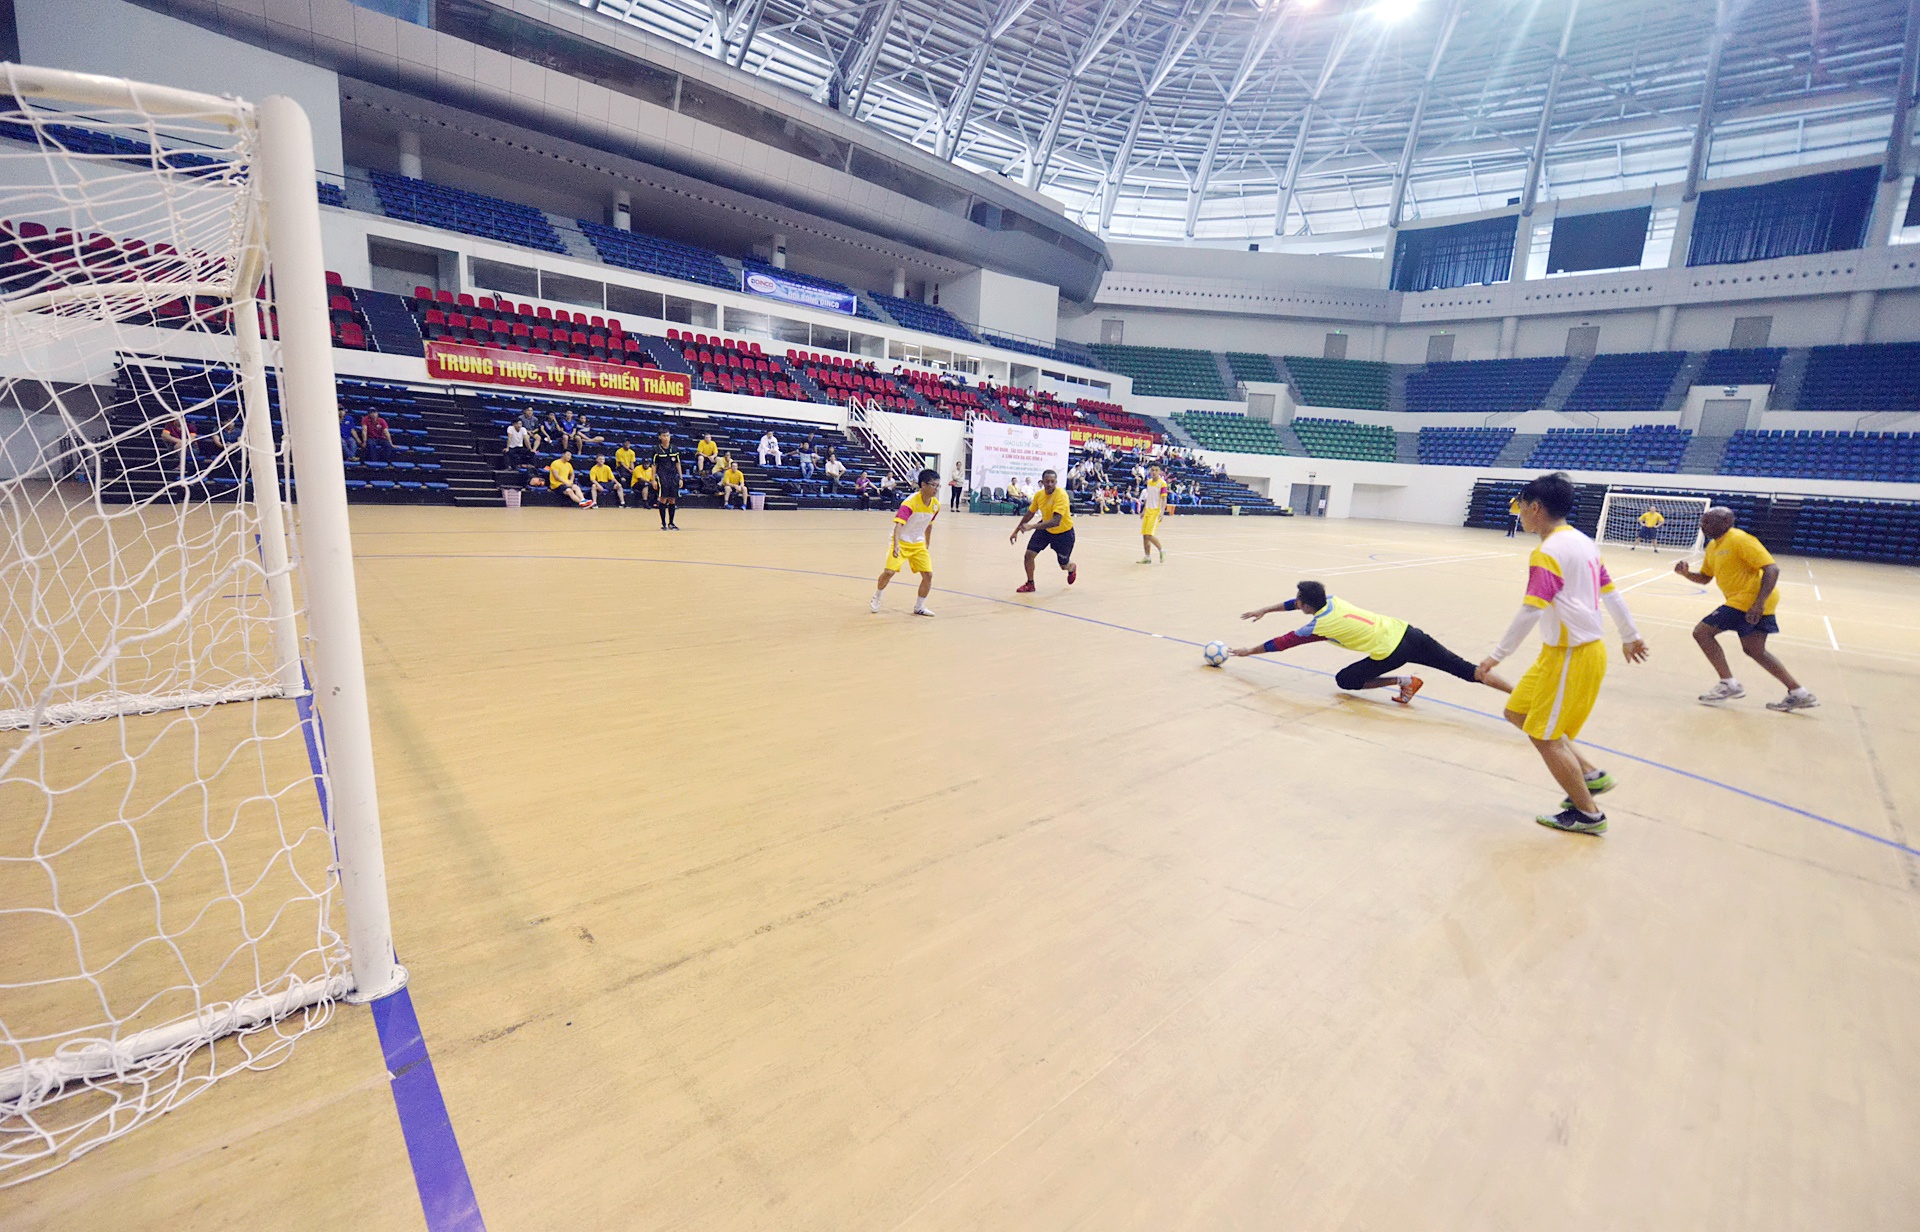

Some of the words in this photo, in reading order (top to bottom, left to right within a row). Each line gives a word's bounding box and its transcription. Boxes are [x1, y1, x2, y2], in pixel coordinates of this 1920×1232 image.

[755, 279, 774, 288] DINCO
[820, 299, 840, 309] DINCO
[436, 352, 493, 376] TRUNG
[497, 359, 542, 383] THỰC,
[546, 364, 566, 386] TỰ
[568, 369, 596, 389] TIN,
[599, 371, 640, 392] CHIẾN
[642, 374, 684, 397] THẮNG
[1343, 613, 1375, 626] 1
